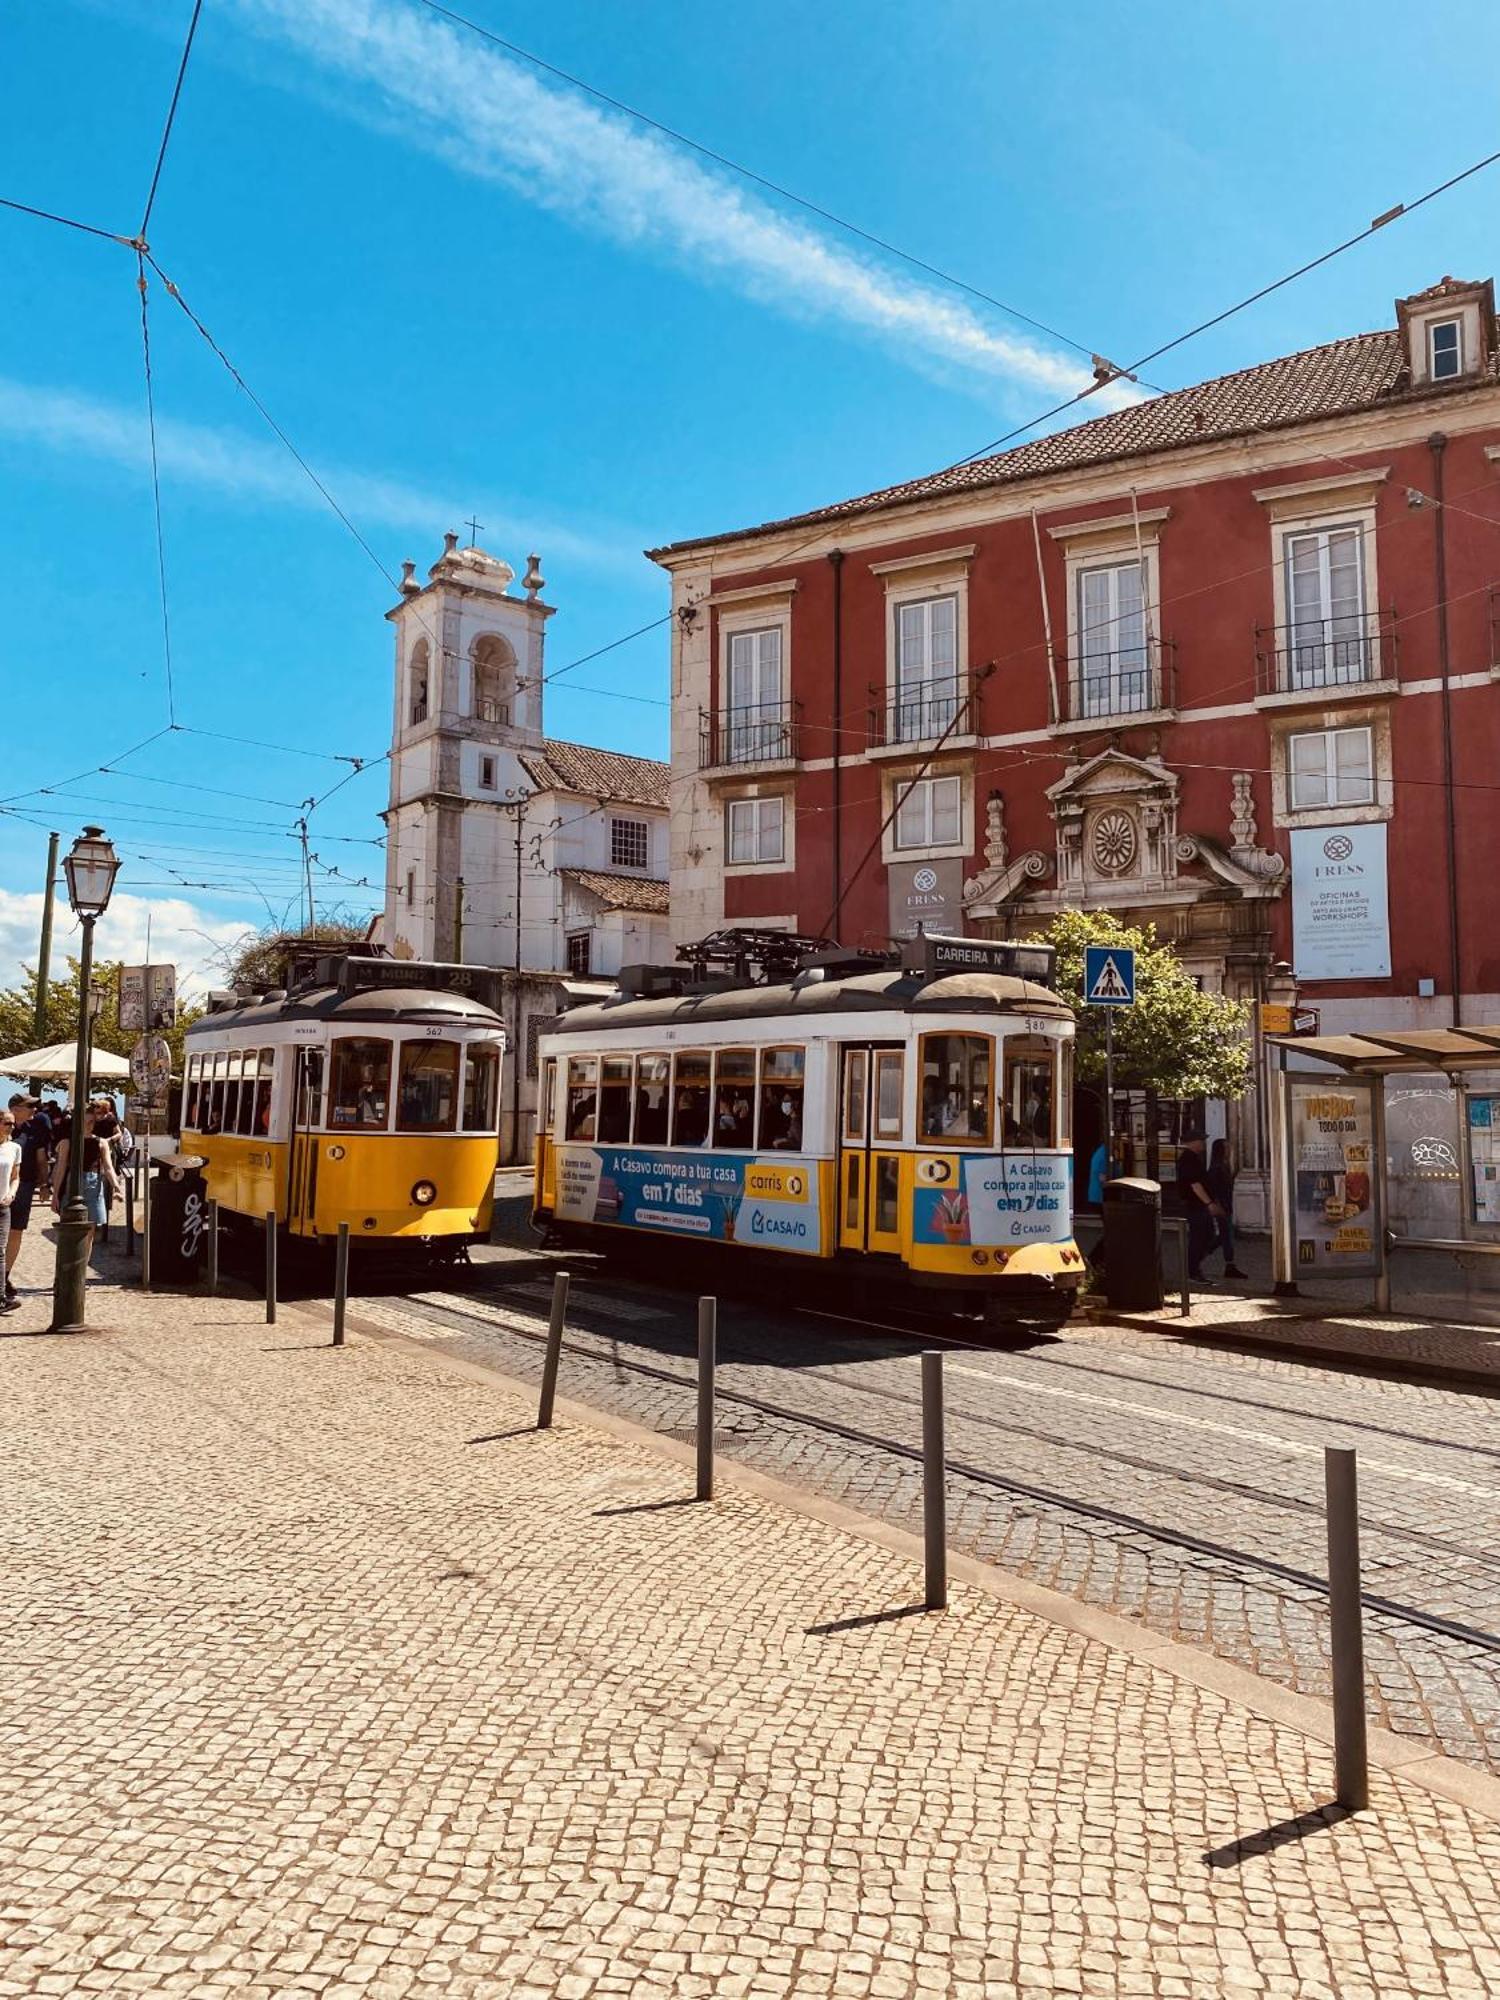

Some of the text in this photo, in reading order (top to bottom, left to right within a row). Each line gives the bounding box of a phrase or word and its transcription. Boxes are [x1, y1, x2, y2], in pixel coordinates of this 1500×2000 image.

[1319, 891, 1360, 900] OFICINAS
[1312, 911, 1369, 921] WORKSHOPS
[936, 946, 989, 964] CARREIRA
[449, 970, 472, 987] 28
[425, 1027, 442, 1036] 562
[1025, 1019, 1045, 1031] 580
[613, 1157, 737, 1182] A Casavo compra a tua casa
[1010, 1164, 1052, 1176] A Casavo
[751, 1172, 782, 1190] carris
[983, 1180, 1026, 1192] compra
[1028, 1181, 1034, 1190] a
[1036, 1180, 1050, 1190] tua
[642, 1182, 703, 1206] em 7 dias
[997, 1195, 1059, 1212] em 7 dias
[766, 1219, 806, 1237] CASAVO
